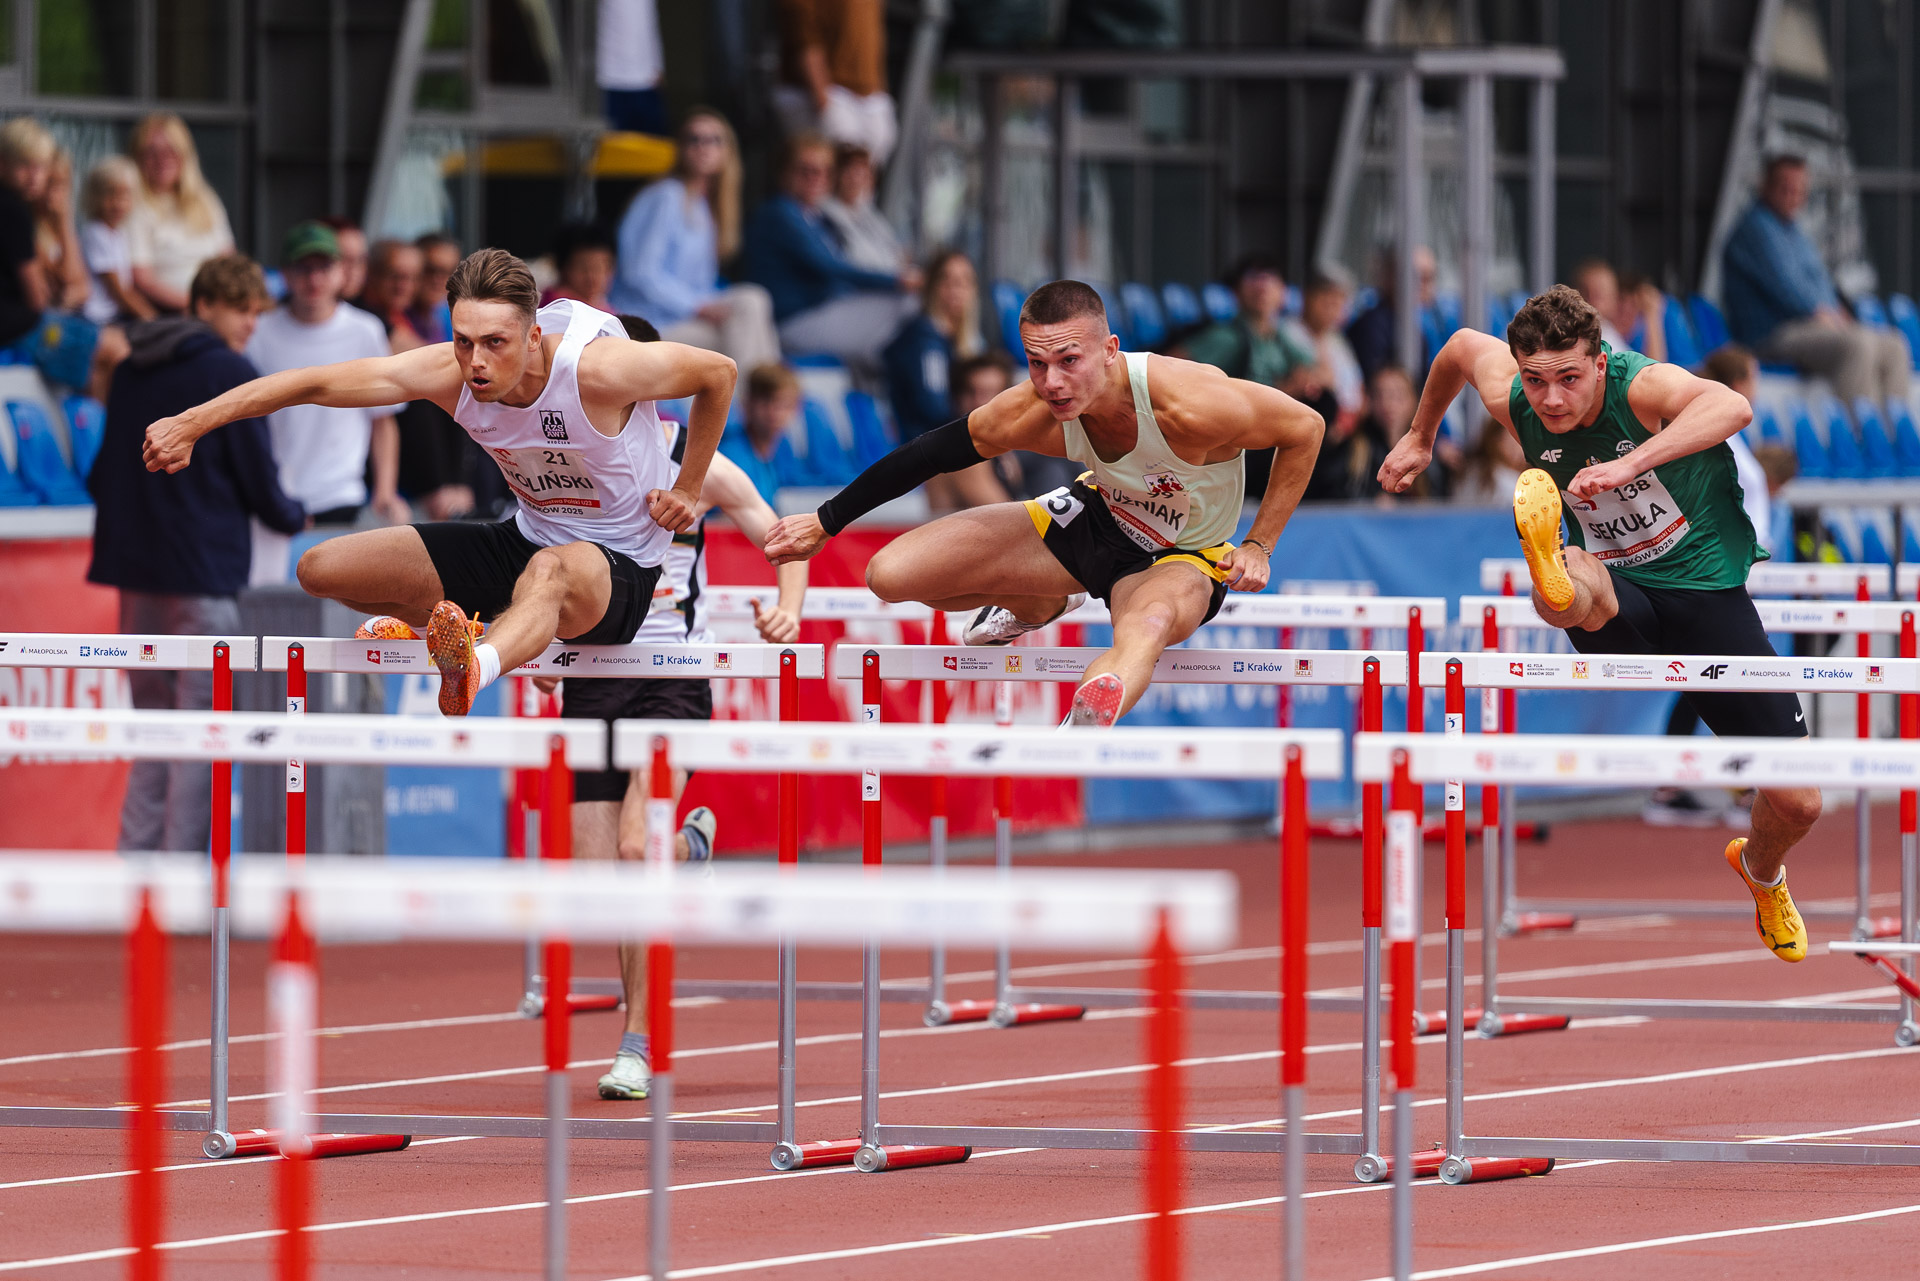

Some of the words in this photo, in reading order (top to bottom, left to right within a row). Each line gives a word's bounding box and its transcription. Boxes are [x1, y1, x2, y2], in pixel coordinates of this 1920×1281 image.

[544, 424, 564, 432] AZS
[542, 450, 570, 466] 21
[1540, 449, 1563, 463] 4F
[1613, 478, 1651, 502] 138
[561, 507, 584, 515] 2025
[1588, 502, 1668, 541] SEKUŁA
[1652, 531, 1669, 545] Polski
[1667, 522, 1680, 533] U23
[1135, 533, 1155, 551] 2025
[1610, 551, 1652, 568] KRAKÓW
[1652, 537, 1675, 556] 2025
[93, 647, 128, 657] Kraków
[552, 652, 580, 667] 4F
[667, 656, 701, 665] Kraków
[1247, 662, 1282, 672] Kraków
[1700, 664, 1729, 680] 4F
[1817, 669, 1853, 678] Kraków
